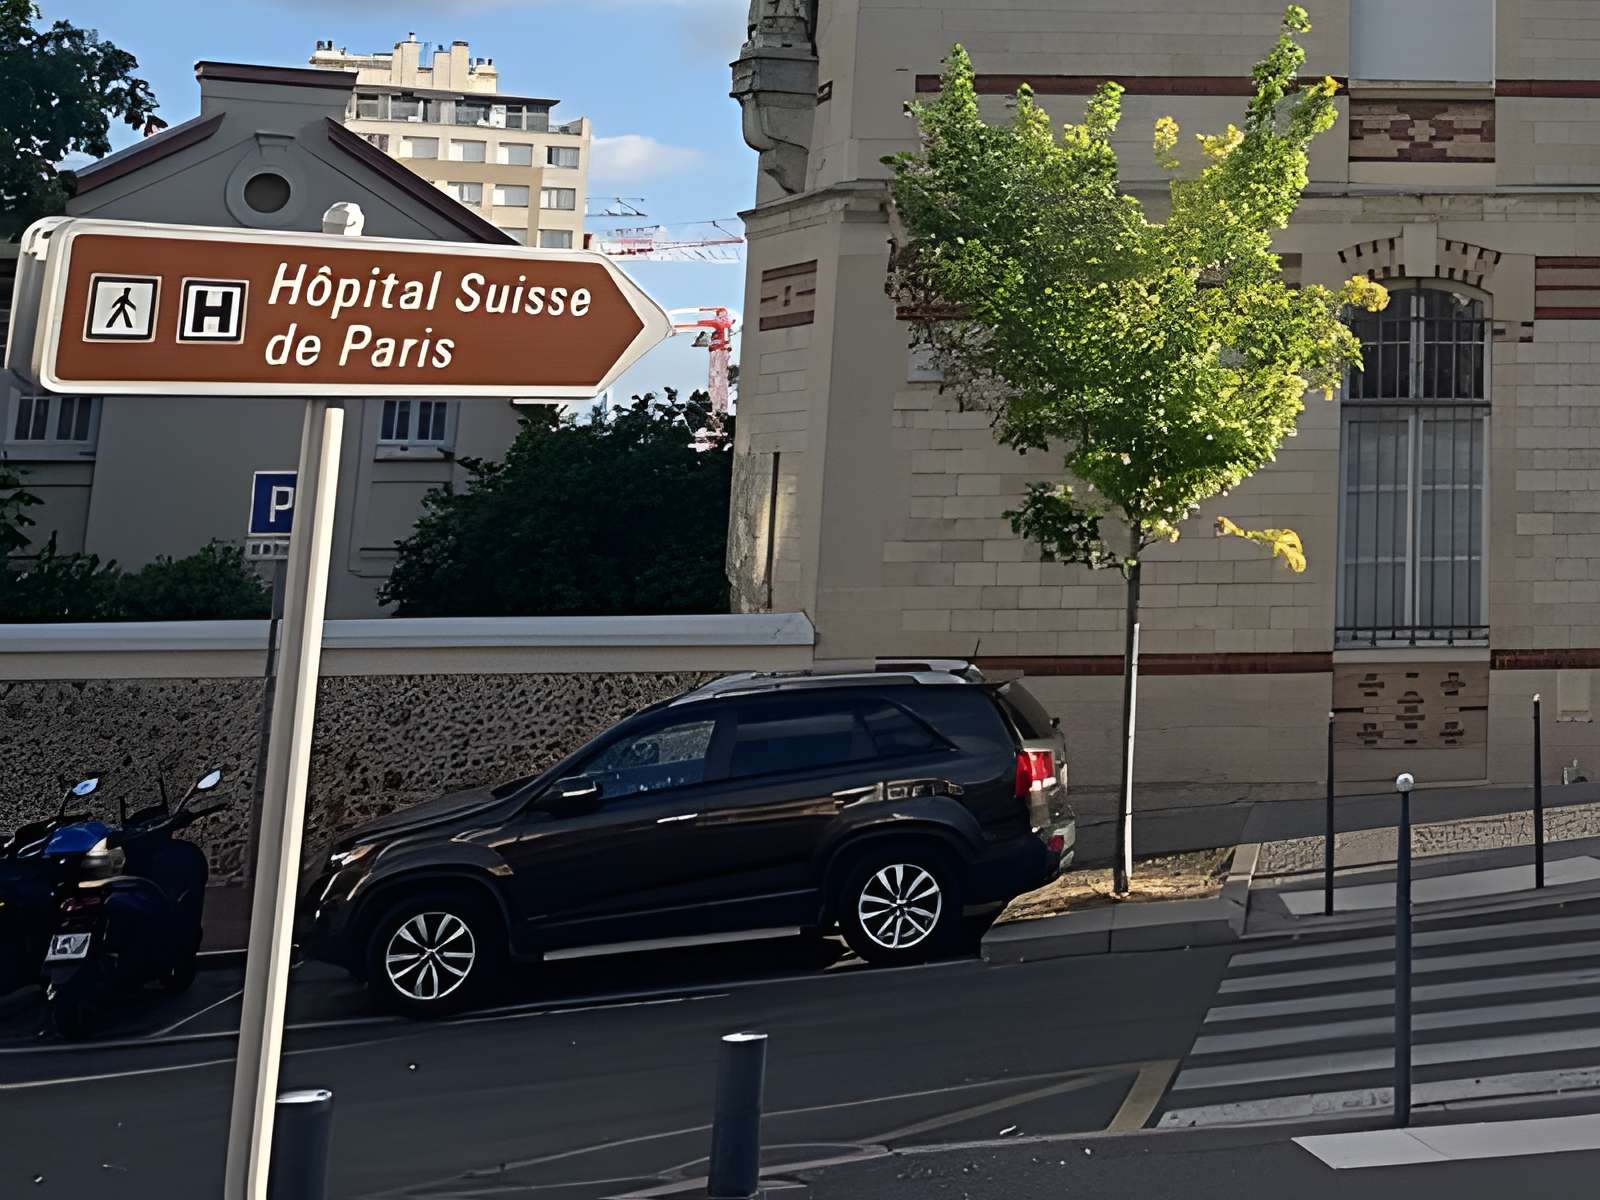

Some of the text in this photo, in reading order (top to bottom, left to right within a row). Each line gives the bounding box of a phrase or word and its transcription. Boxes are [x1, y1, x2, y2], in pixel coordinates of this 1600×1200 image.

[193, 290, 233, 334] H
[268, 262, 592, 319] Hôpital Suisse
[265, 323, 455, 369] de Paris
[269, 485, 295, 523] P
